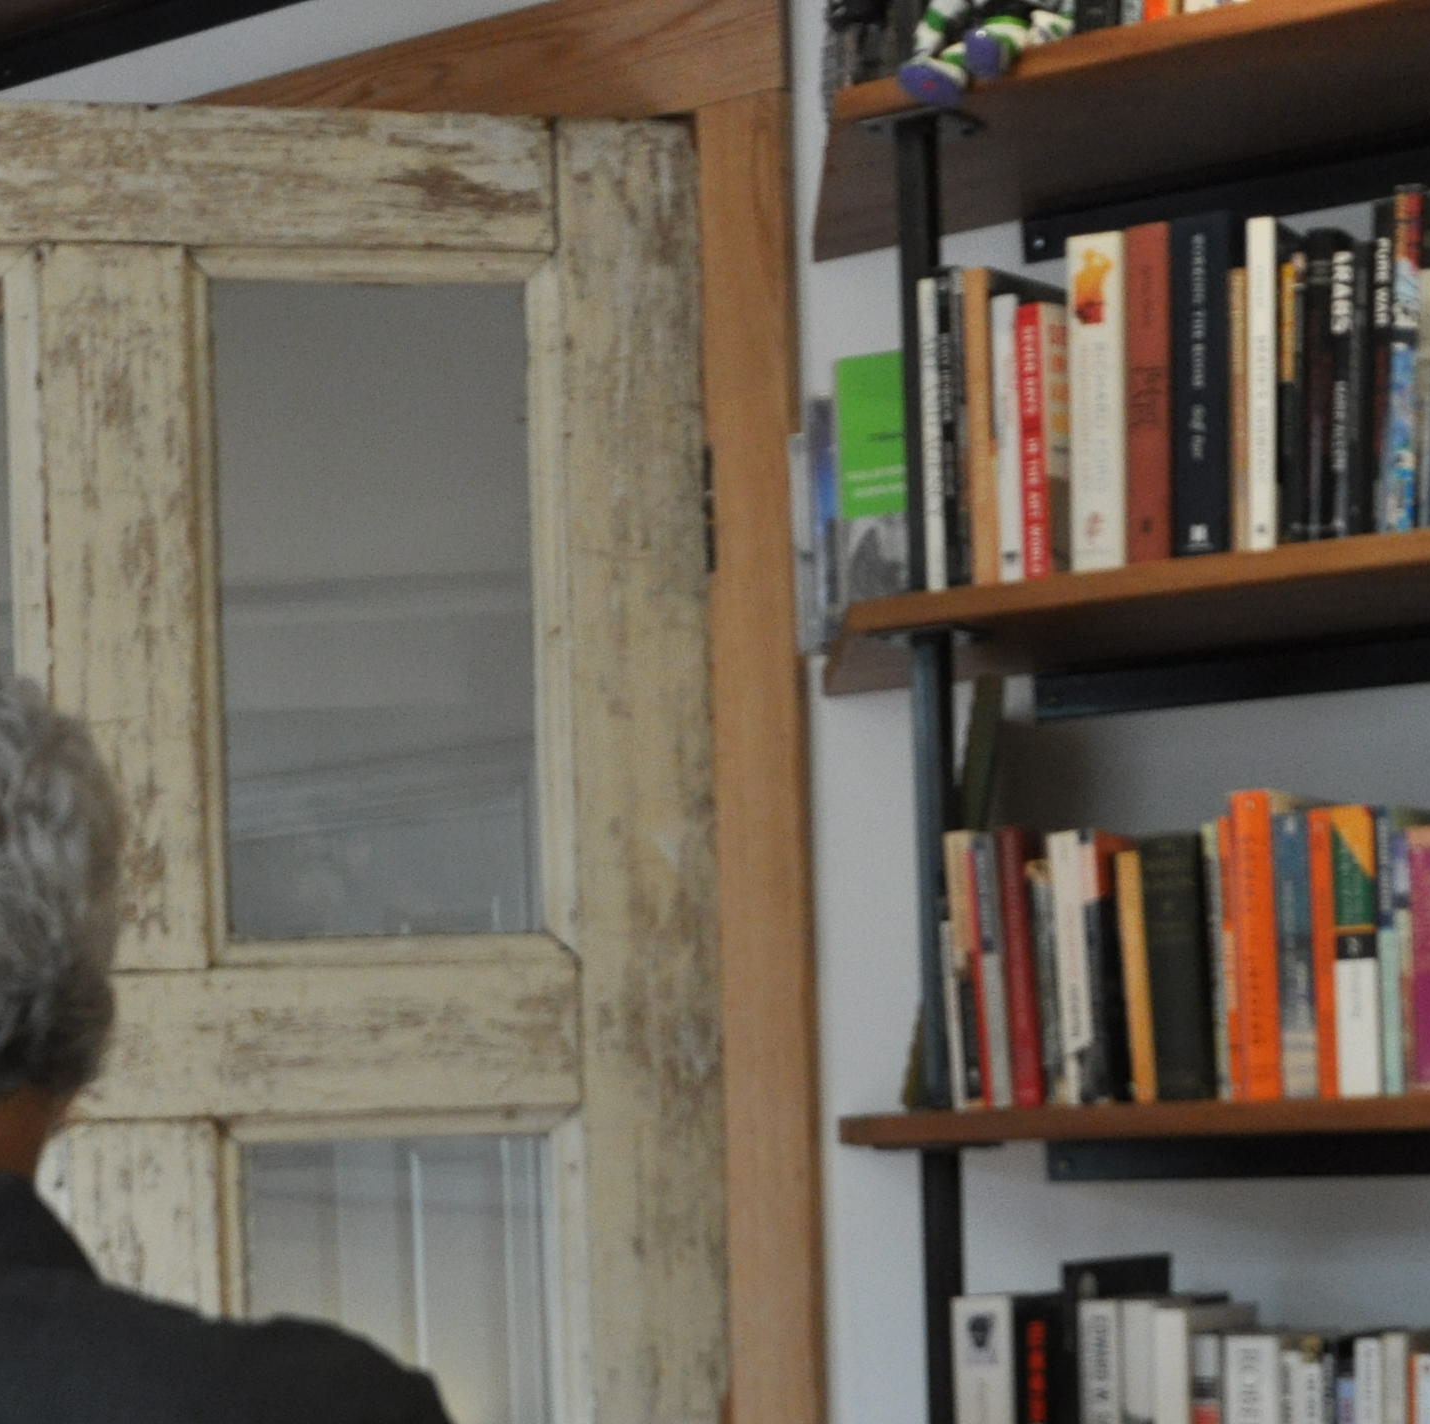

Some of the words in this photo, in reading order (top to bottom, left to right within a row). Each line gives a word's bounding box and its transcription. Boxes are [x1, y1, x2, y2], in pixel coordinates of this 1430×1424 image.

[1374, 238, 1393, 283] PURE
[1374, 287, 1392, 329] WAR
[1028, 526, 1045, 575] WORLD
